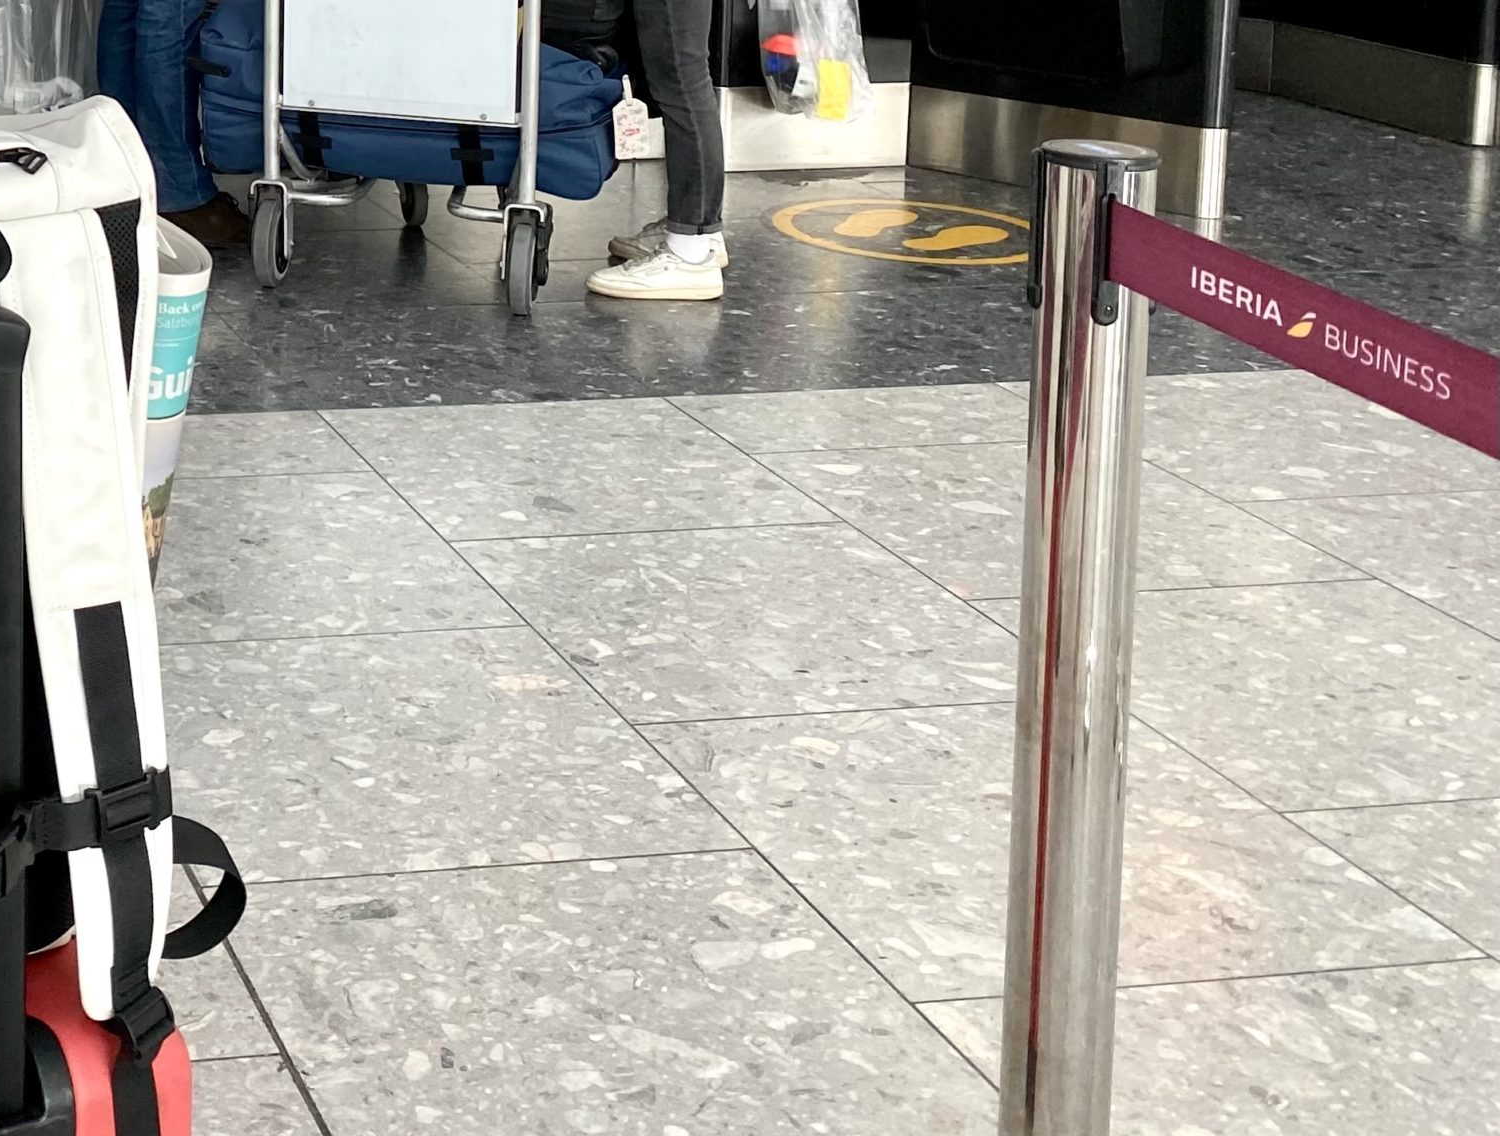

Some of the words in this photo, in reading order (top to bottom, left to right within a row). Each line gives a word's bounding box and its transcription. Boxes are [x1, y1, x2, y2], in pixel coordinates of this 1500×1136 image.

[158, 302, 190, 315] Back
[1191, 265, 1283, 327] IBERIA
[1324, 322, 1452, 401] BUSINESS
